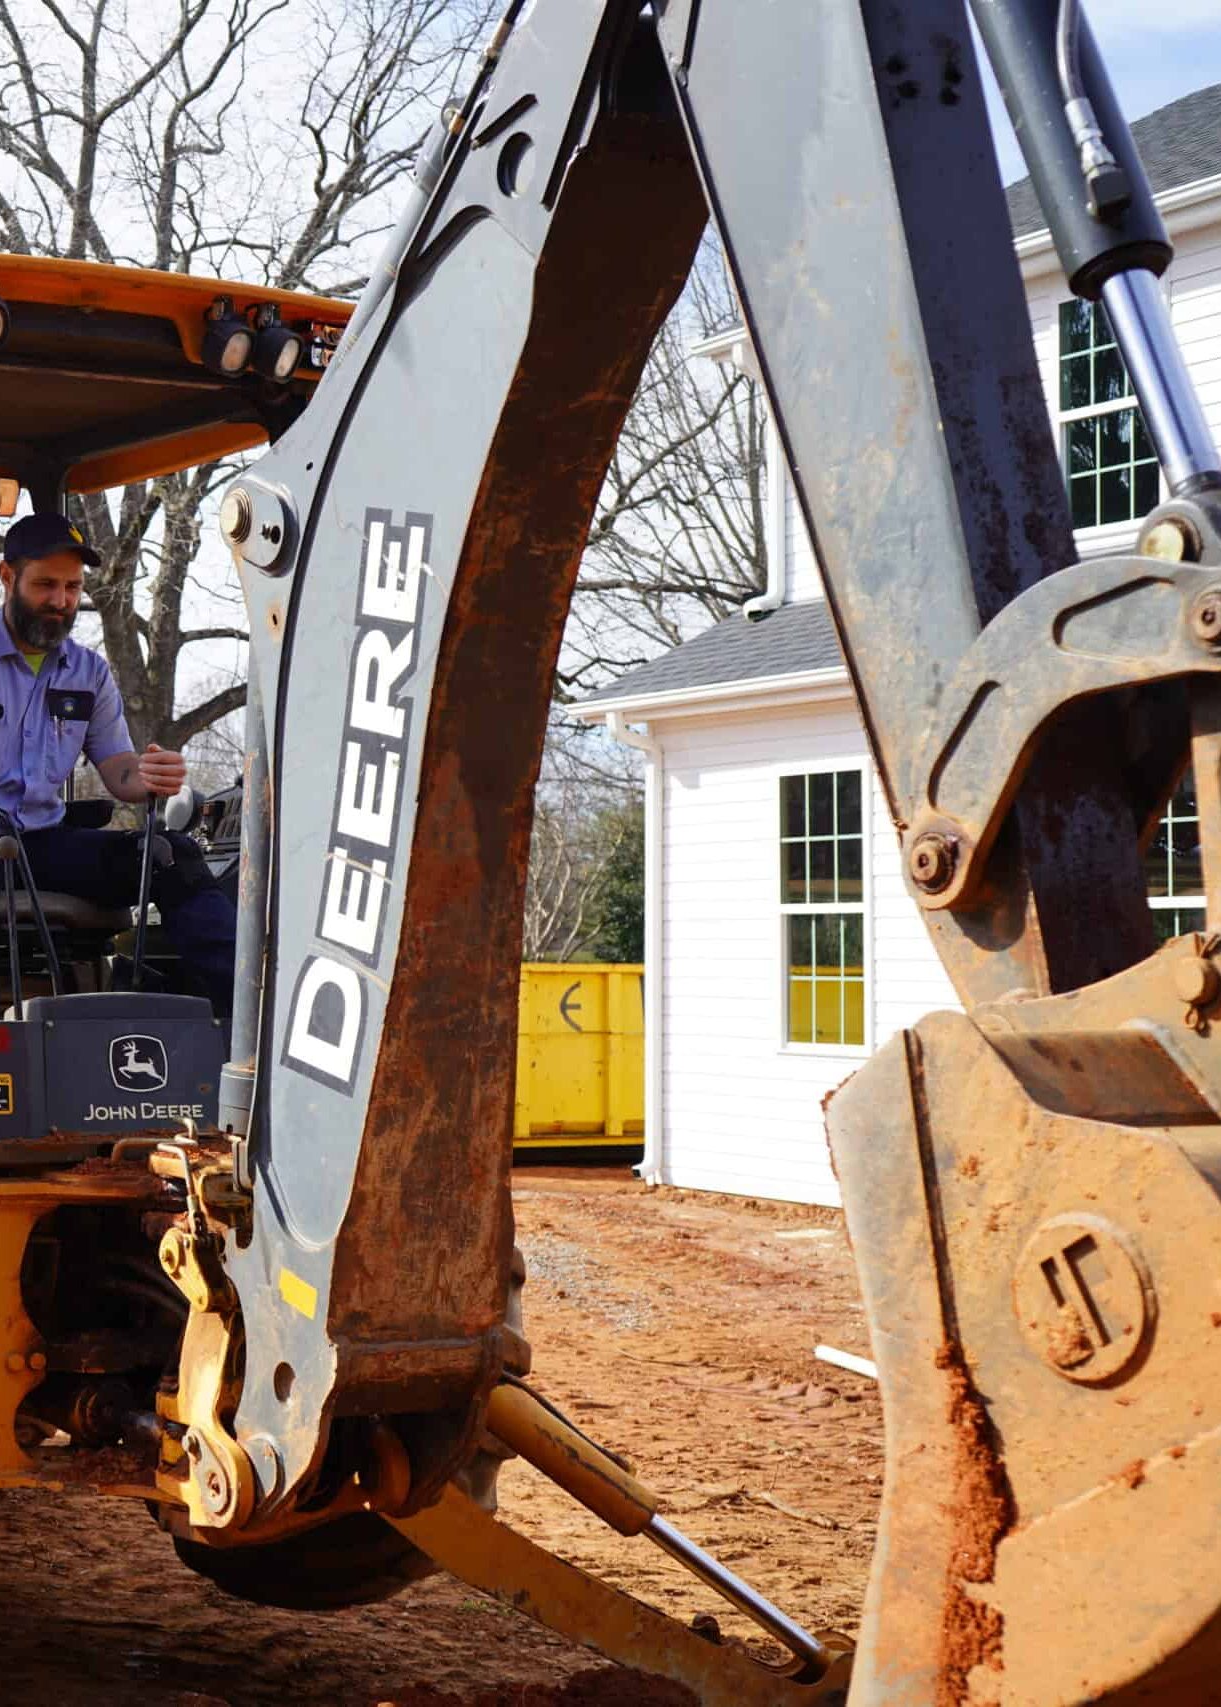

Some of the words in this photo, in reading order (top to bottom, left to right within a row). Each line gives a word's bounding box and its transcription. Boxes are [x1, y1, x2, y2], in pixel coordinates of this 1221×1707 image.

[288, 520, 426, 1083] DEERE
[83, 1103, 137, 1120] JOHN
[140, 1102, 204, 1119] DEERE
